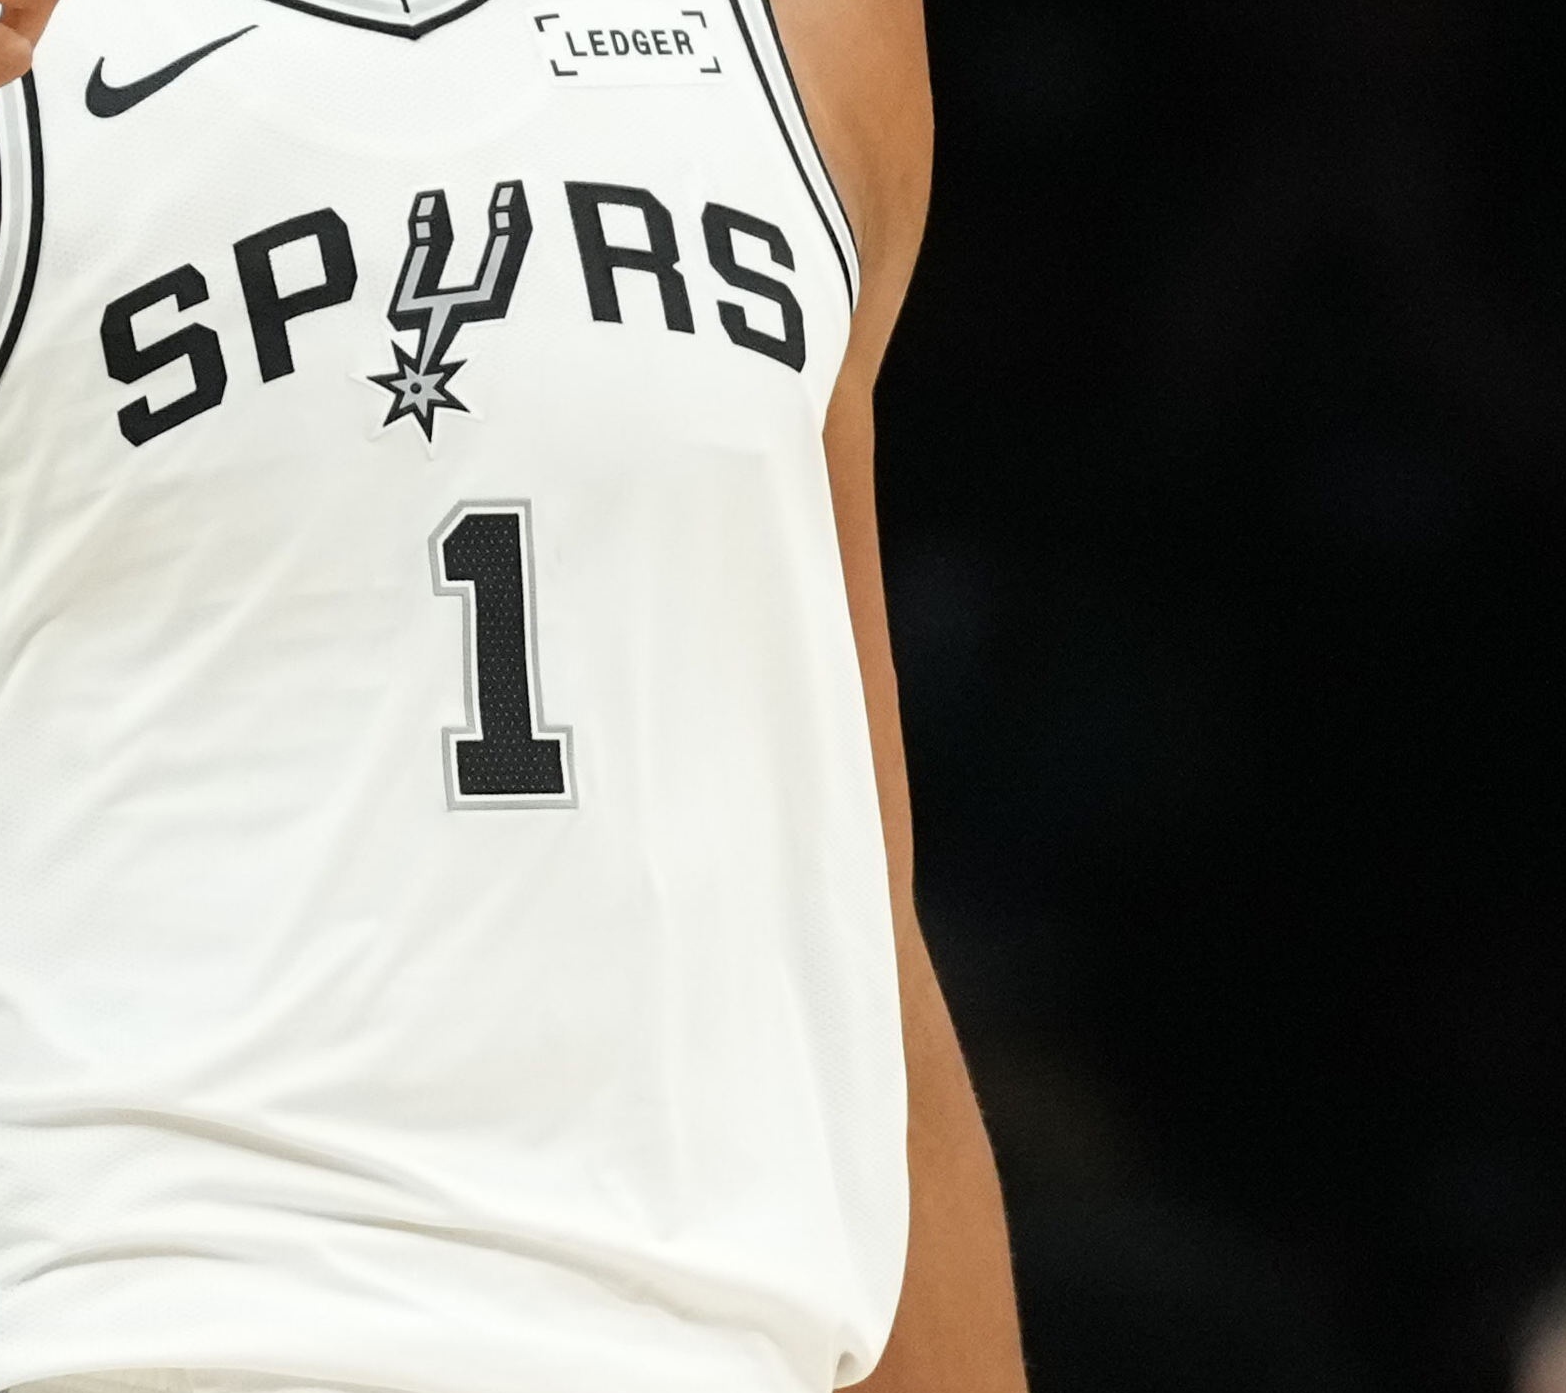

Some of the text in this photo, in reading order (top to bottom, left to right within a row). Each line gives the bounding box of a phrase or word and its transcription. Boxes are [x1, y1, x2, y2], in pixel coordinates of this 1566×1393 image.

[565, 29, 695, 57] LEDGER
[99, 179, 808, 447] SPURS
[427, 498, 579, 811] 1
